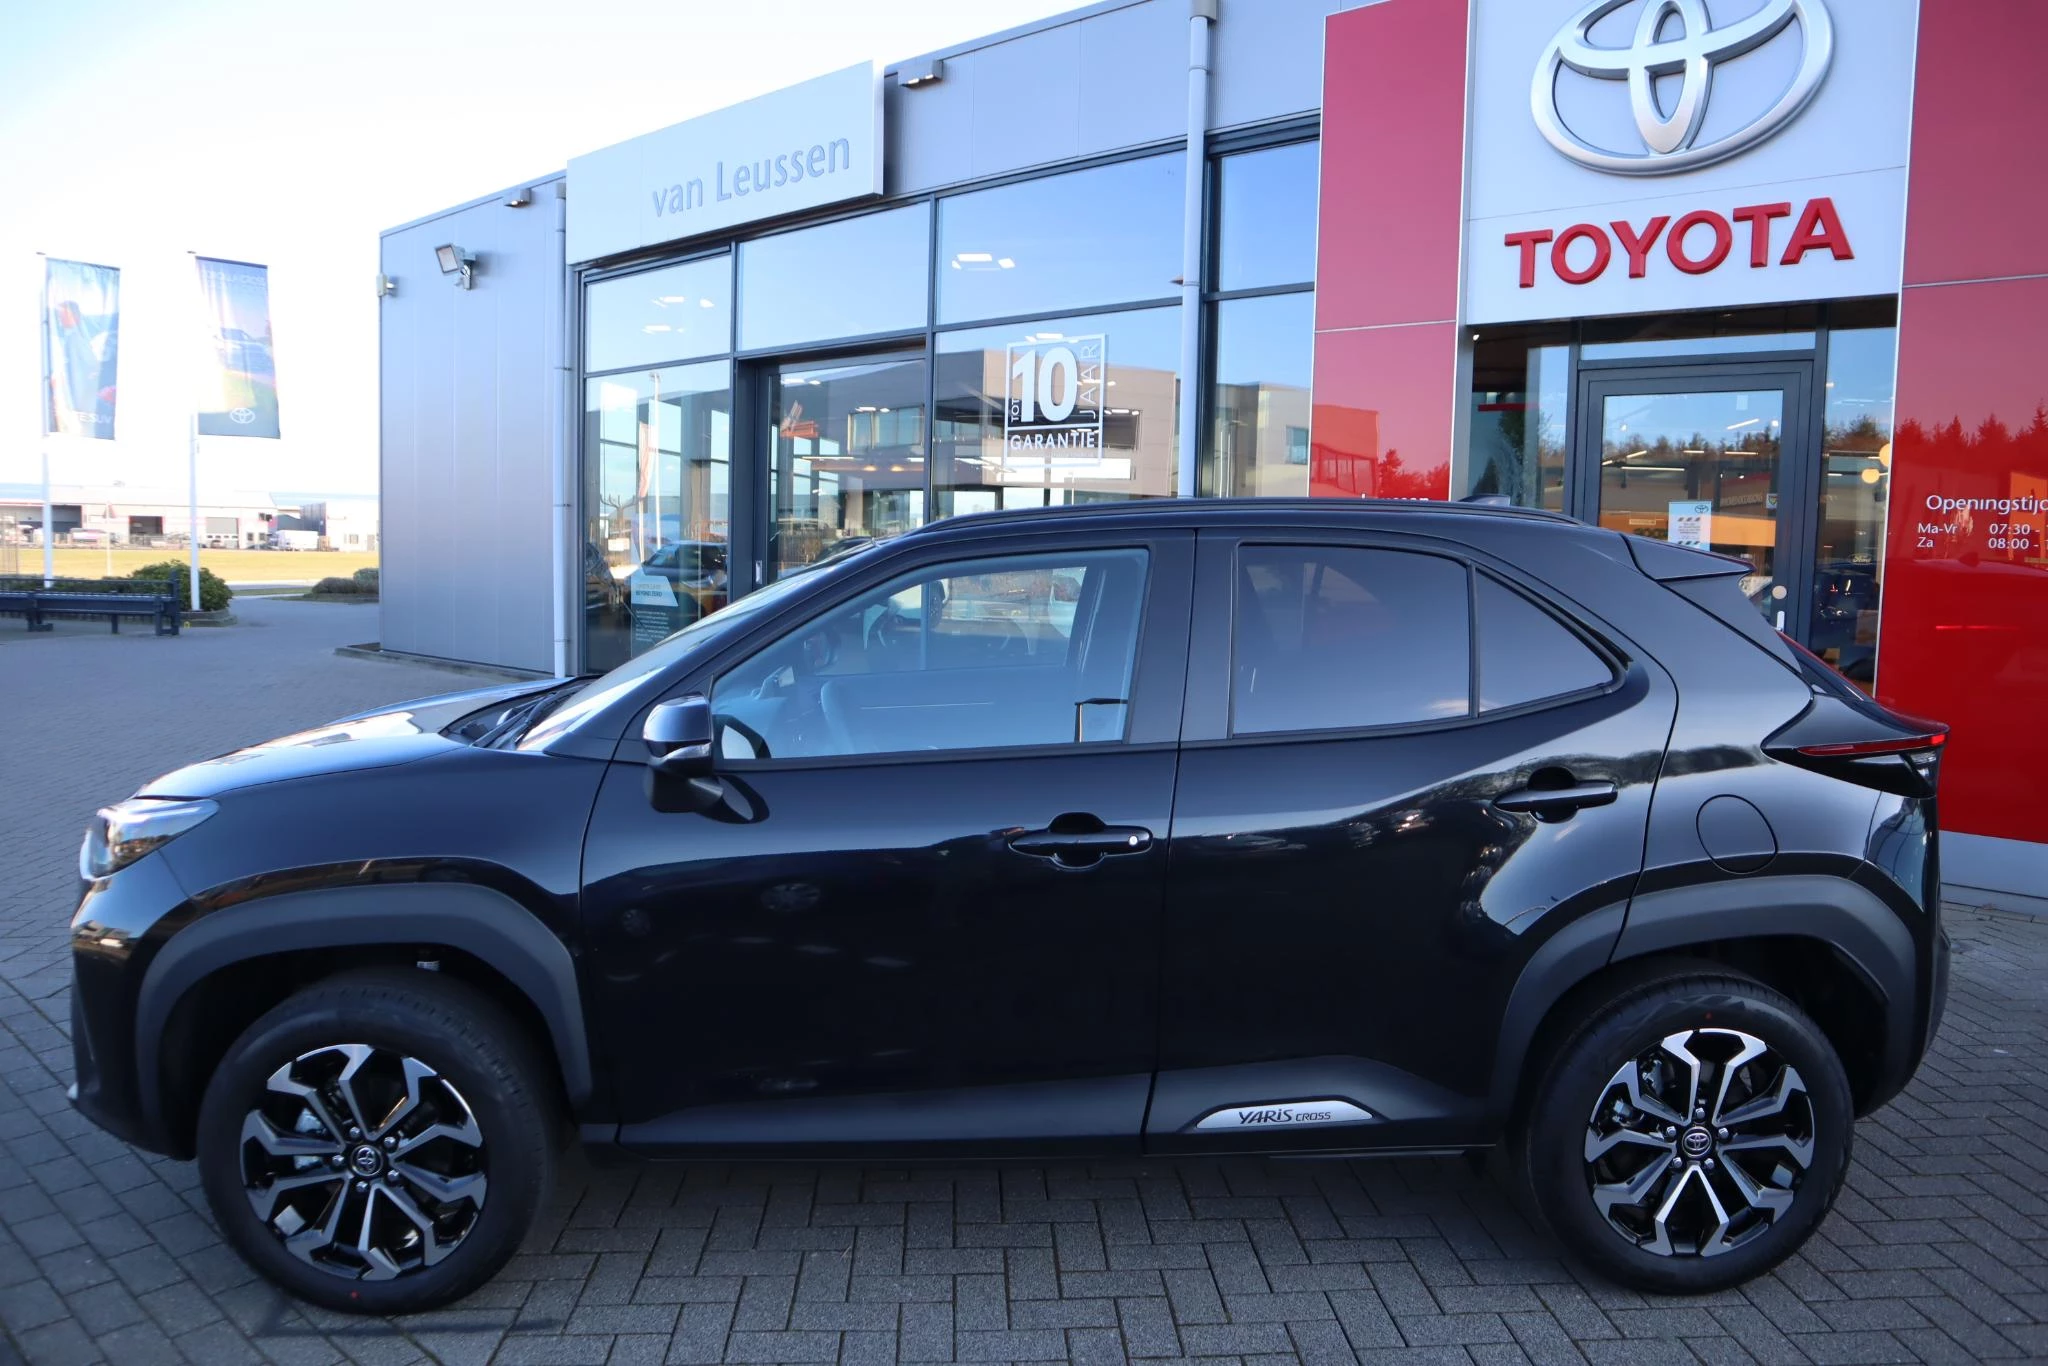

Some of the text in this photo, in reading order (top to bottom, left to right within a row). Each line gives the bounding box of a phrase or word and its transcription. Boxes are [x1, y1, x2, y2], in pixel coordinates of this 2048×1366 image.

[652, 137, 850, 218] van Leussen
[1504, 196, 1856, 289] TOYOTA
[1012, 347, 1078, 423] 10
[1079, 343, 1099, 420] JAAR
[1010, 397, 1021, 423] TOT
[1010, 432, 1095, 450] GARANTIE
[1916, 536, 1934, 548] Za
[1988, 537, 2030, 550] 08:00
[1917, 522, 1958, 535] Ma-Vr
[1989, 523, 2031, 535] 07:30
